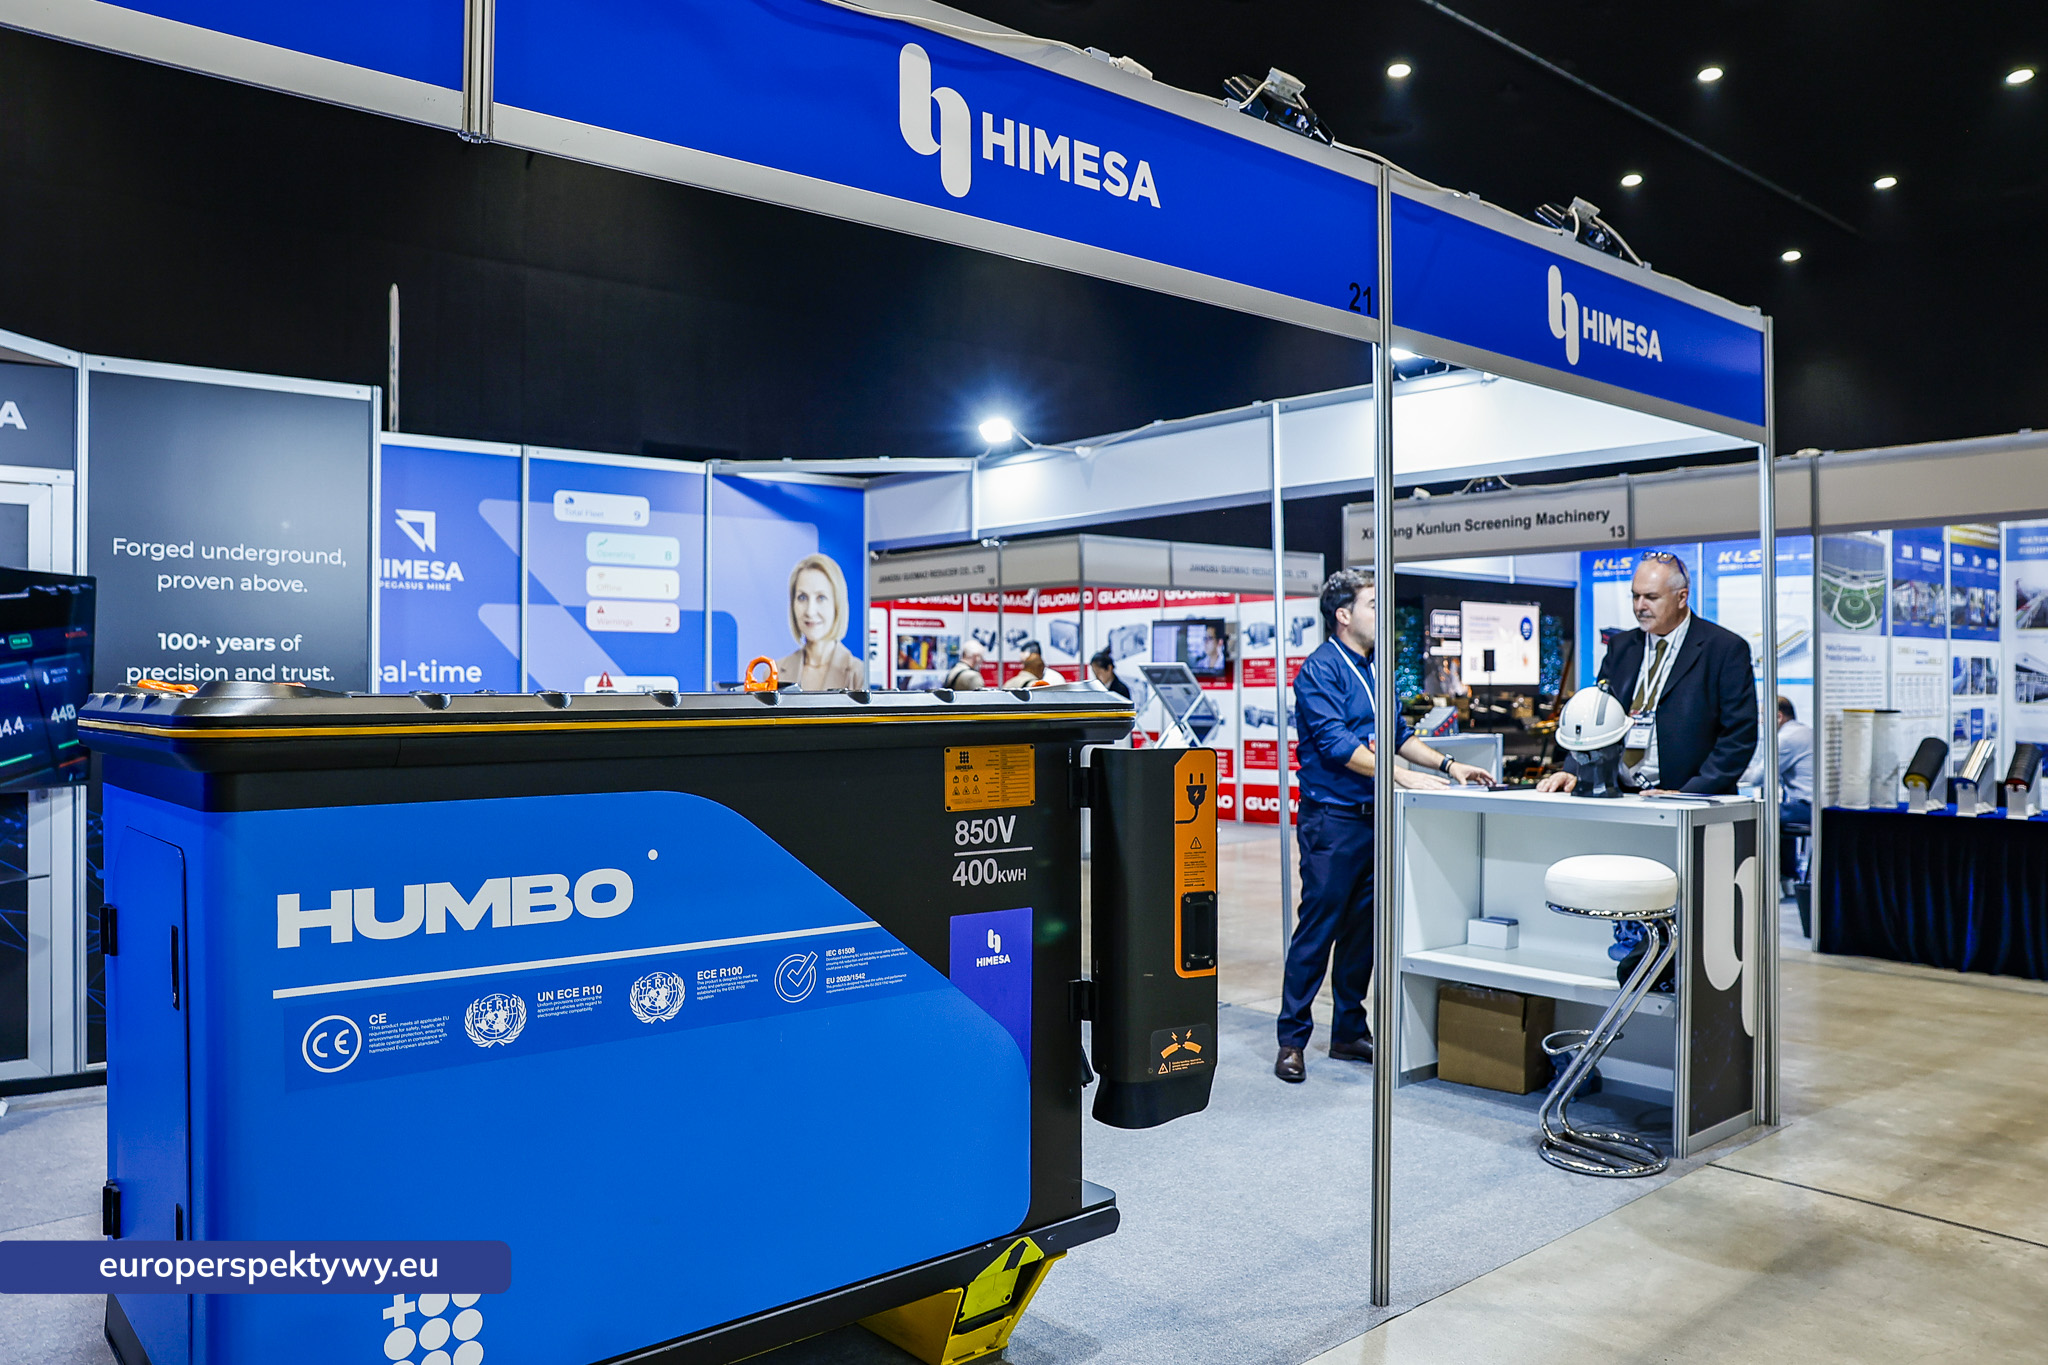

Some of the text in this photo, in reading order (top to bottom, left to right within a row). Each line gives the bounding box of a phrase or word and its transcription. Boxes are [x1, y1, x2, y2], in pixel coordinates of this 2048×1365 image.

[982, 111, 1161, 208] HIMESA
[1349, 282, 1371, 315] 21
[1583, 306, 1662, 362] HIMESA
[634, 511, 641, 521] 9
[1416, 522, 1461, 537] Kunlun
[1465, 515, 1532, 532] Screening
[1536, 509, 1611, 527] Machinery
[1610, 525, 1626, 539] 13
[112, 537, 347, 568] Forged underground,
[379, 558, 465, 582] IMESA
[157, 573, 308, 593] proven above.
[1098, 589, 1159, 605] GUOMAO
[665, 617, 672, 628] 2
[157, 632, 302, 655] 100+ years of
[126, 663, 335, 684] precision and trust.
[954, 815, 1016, 845] 850V
[277, 868, 634, 949] HUMBO
[838, 947, 855, 955] 61508
[976, 954, 1011, 968] HIMESA
[697, 966, 743, 980] ECE R100
[836, 973, 866, 983] 2023/1542
[537, 985, 603, 1002] UN ECE R10
[369, 1013, 387, 1025] CE
